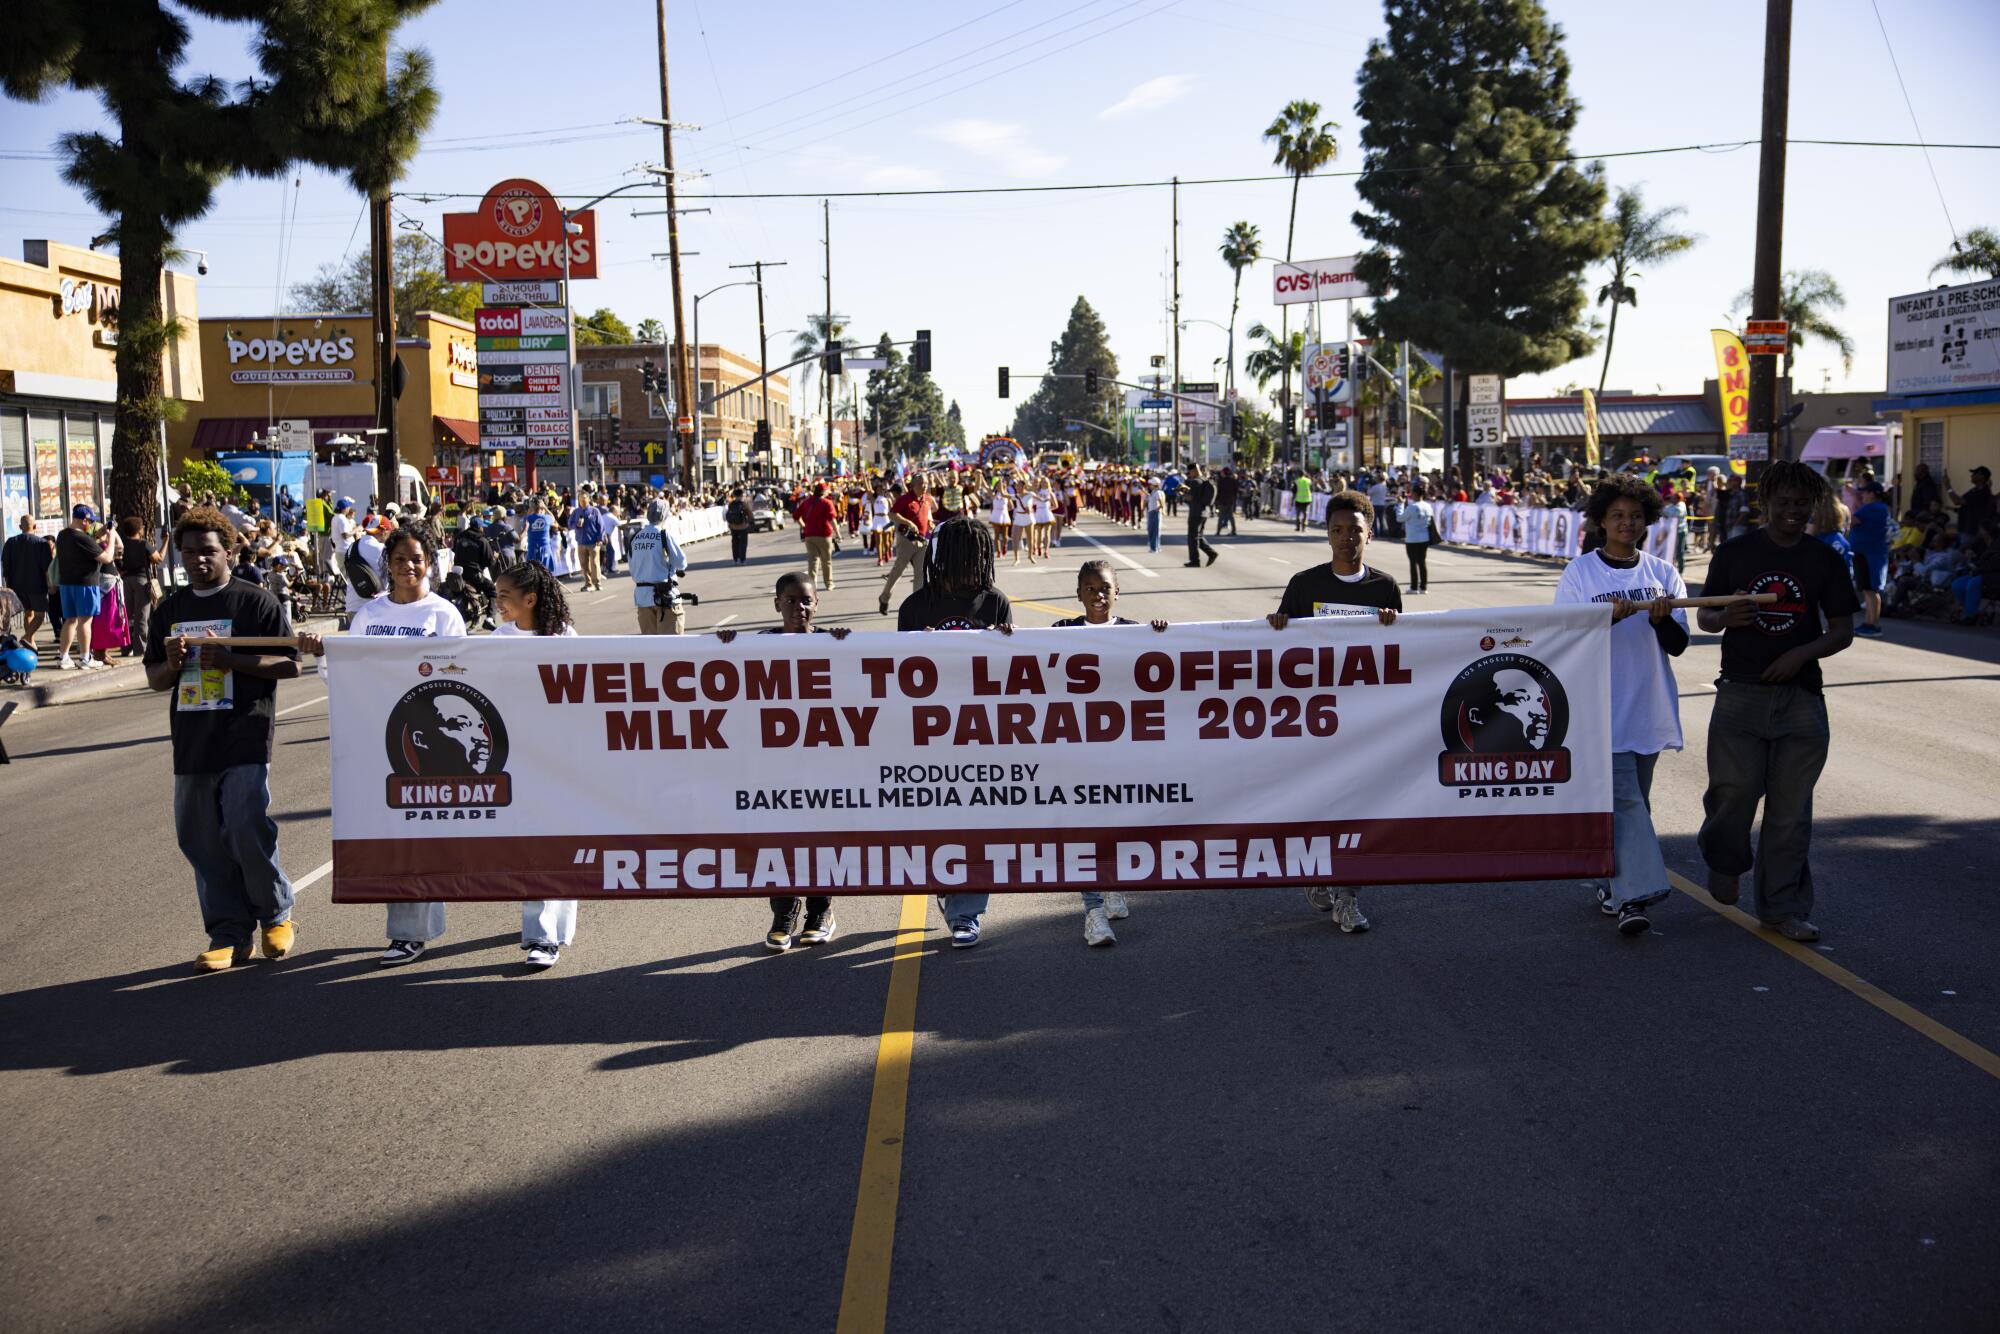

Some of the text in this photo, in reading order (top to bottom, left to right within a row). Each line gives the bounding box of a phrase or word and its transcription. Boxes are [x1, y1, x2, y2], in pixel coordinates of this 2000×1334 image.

[513, 284, 541, 292] HOUR
[1896, 297, 1933, 314] INFANT
[1937, 295, 1944, 307] &
[1907, 313, 1923, 322] CHILD
[1925, 309, 1939, 319] CARE
[1947, 303, 1981, 316] EDUCATION
[480, 313, 518, 330] total
[491, 337, 552, 348] SUBWAY
[235, 371, 348, 380] LOUISIANA KITCHEN
[480, 395, 524, 406] BEAUTY
[529, 437, 550, 446] Pizza
[1473, 427, 1499, 443] 35
[644, 442, 663, 464] 1%
[634, 543, 655, 551] STAFF
[1628, 588, 1644, 601] NOT
[1783, 577, 1801, 598] FROM
[538, 644, 1412, 704] WELCOME TO LA'S OFFICIAL
[1461, 656, 1551, 680] LOS ANGELES OFFICIAL
[404, 682, 488, 707] LOS ANGELES OFFICIAL
[605, 694, 1339, 751] MLK DAY PARADE 2026
[880, 764, 1039, 784] PRODUCED BY
[1455, 760, 1554, 781] KING DAY
[401, 784, 496, 804] KING DAY
[735, 783, 1194, 811] BAKEWELL MEDIA AND LA SENTINEL
[1459, 786, 1555, 798] PARADE
[405, 810, 497, 820] PARADE
[573, 833, 1362, 890] "RECLAIMING THE DREAM"
